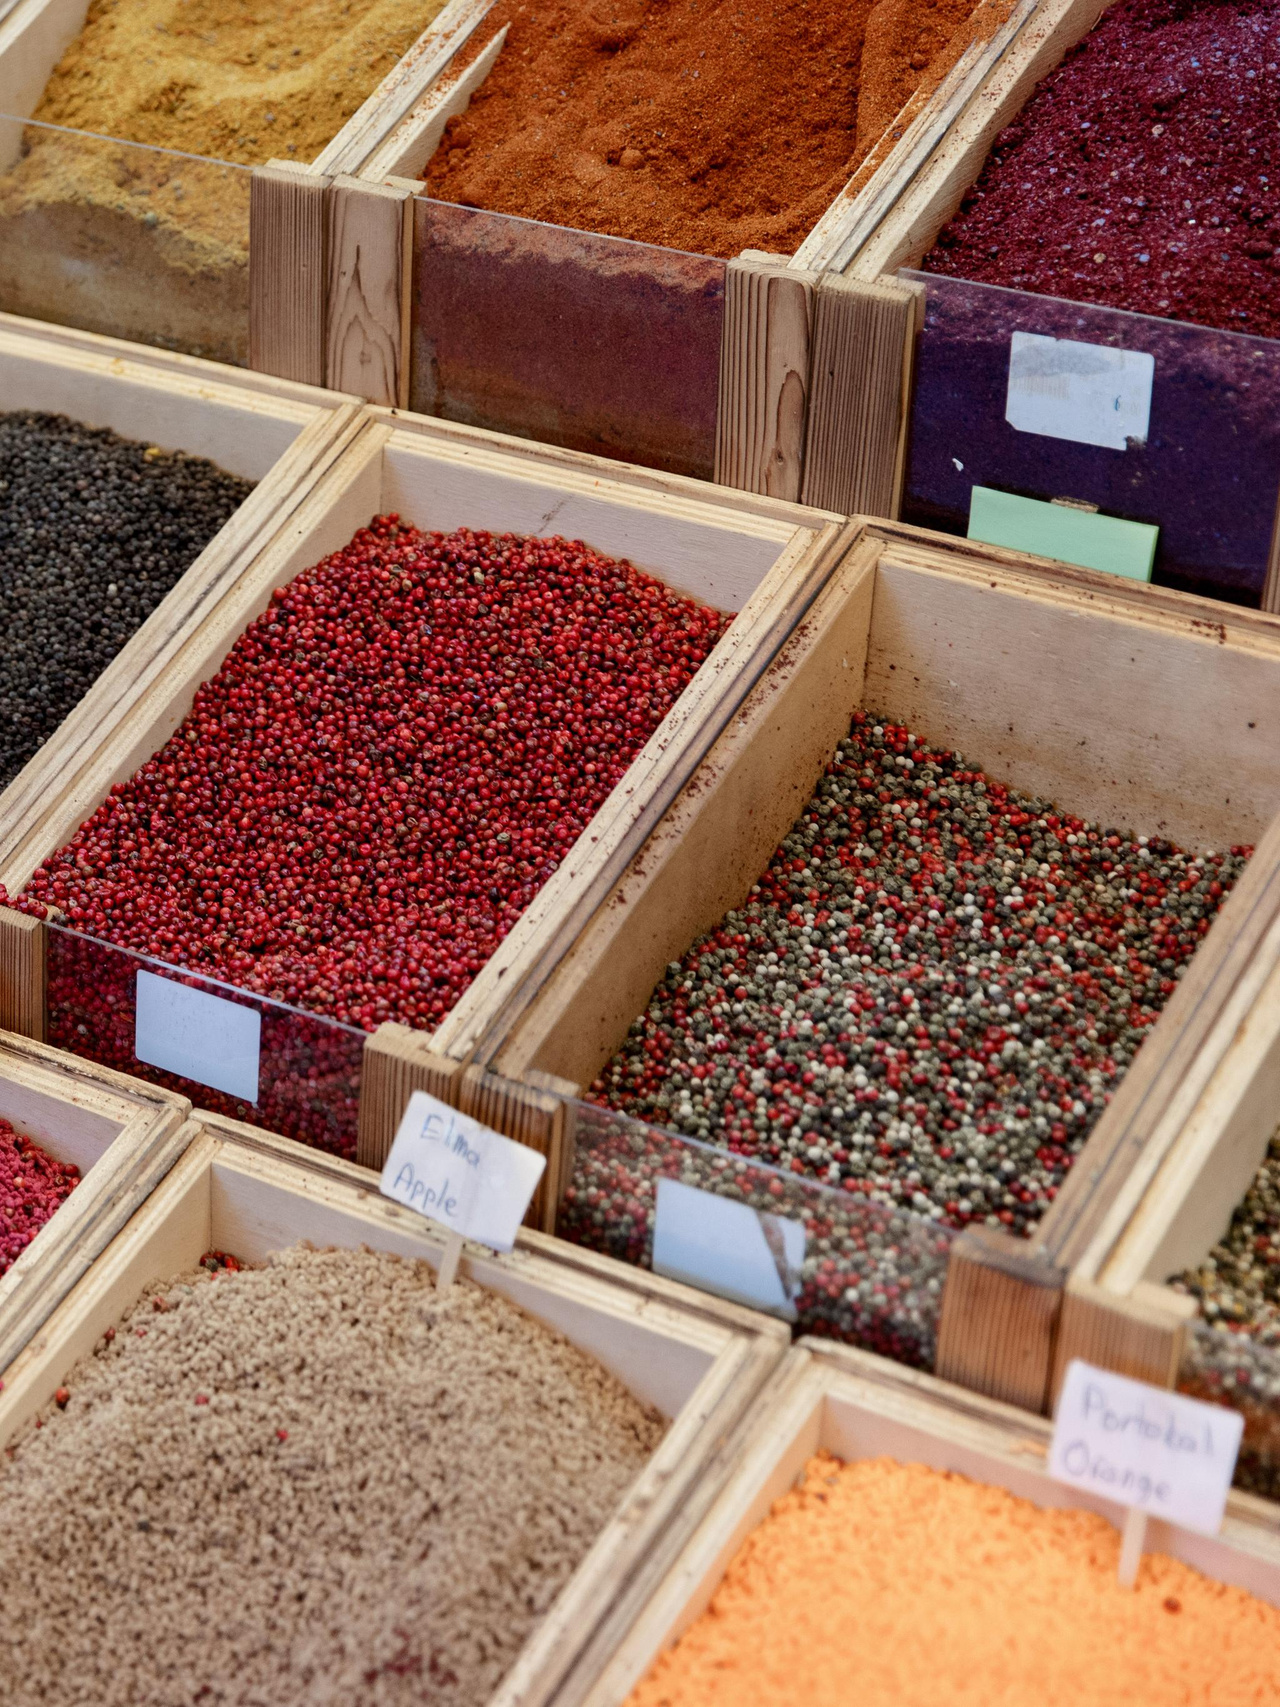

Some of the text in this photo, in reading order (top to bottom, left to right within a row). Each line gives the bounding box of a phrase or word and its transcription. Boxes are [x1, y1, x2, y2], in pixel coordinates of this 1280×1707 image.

[420, 1112, 481, 1169] Elma
[393, 1161, 458, 1218] Apple
[1061, 1438, 1171, 1503] Orange
